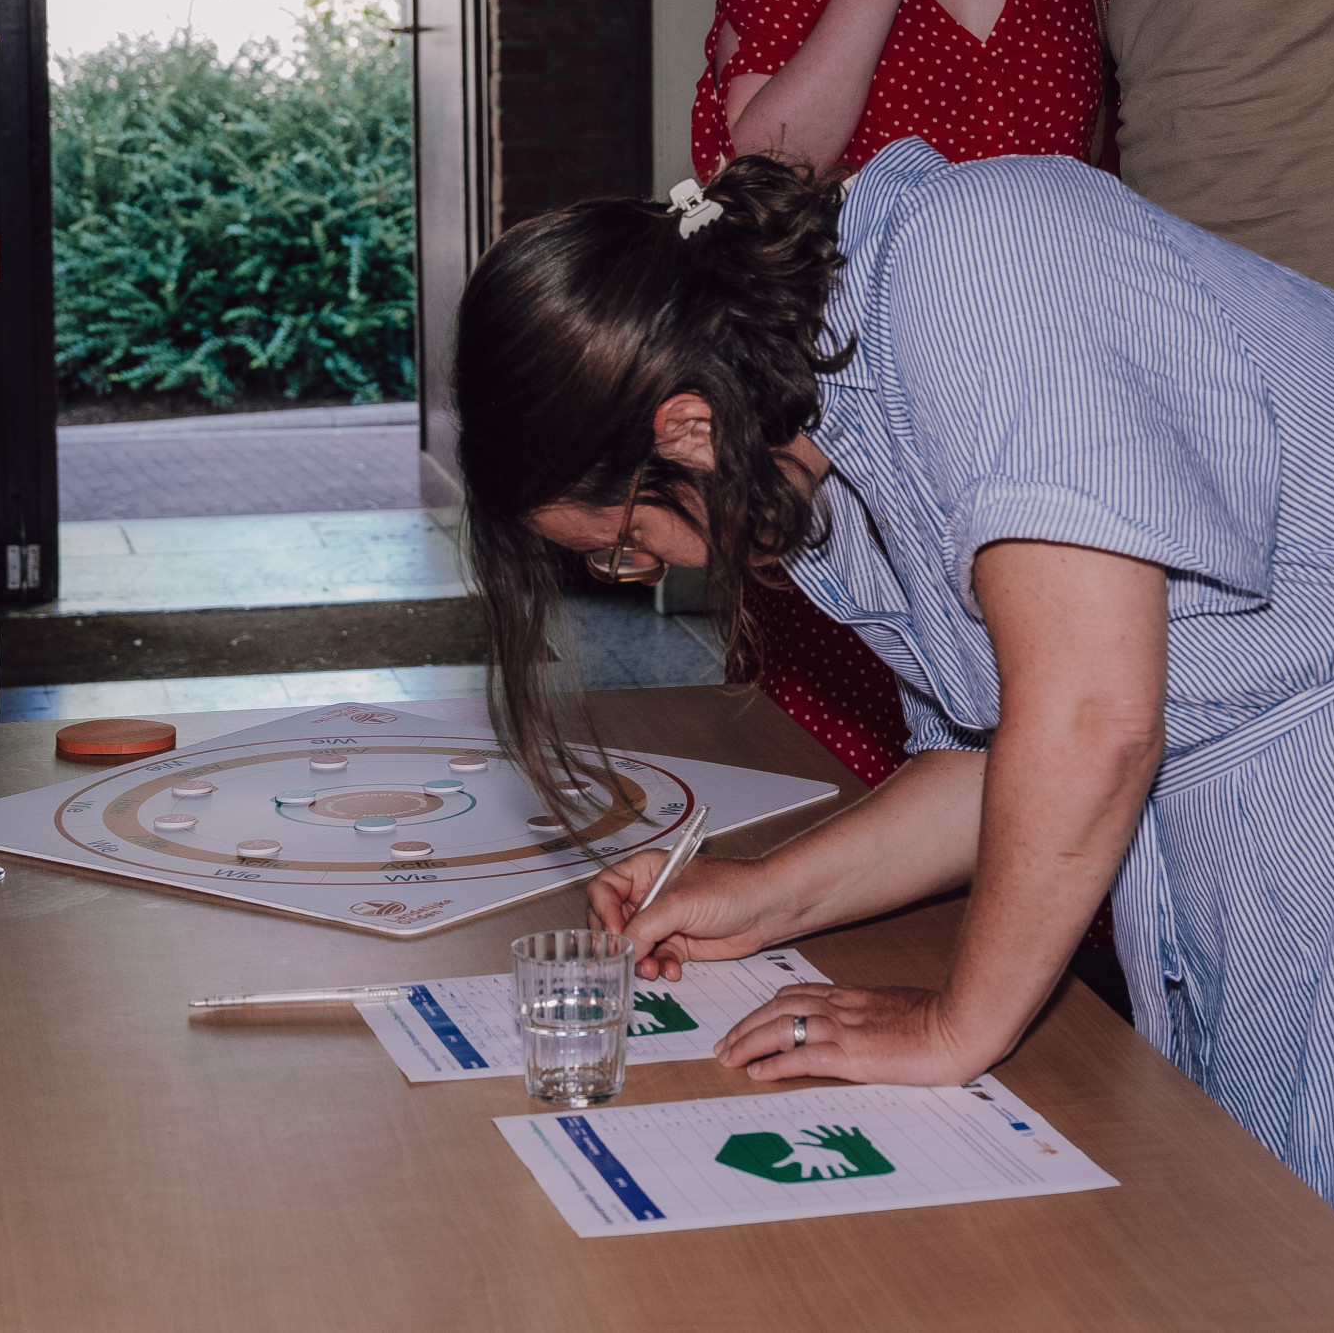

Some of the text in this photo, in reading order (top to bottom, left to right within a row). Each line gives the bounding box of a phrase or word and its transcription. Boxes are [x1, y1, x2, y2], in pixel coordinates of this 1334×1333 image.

[66, 800, 97, 813] Wie
[657, 802, 685, 816] Wie
[87, 838, 120, 853] Wie
[226, 857, 290, 869] Actie
[380, 860, 448, 871] Actie
[213, 868, 262, 880] Wie
[383, 873, 438, 882] Wie
